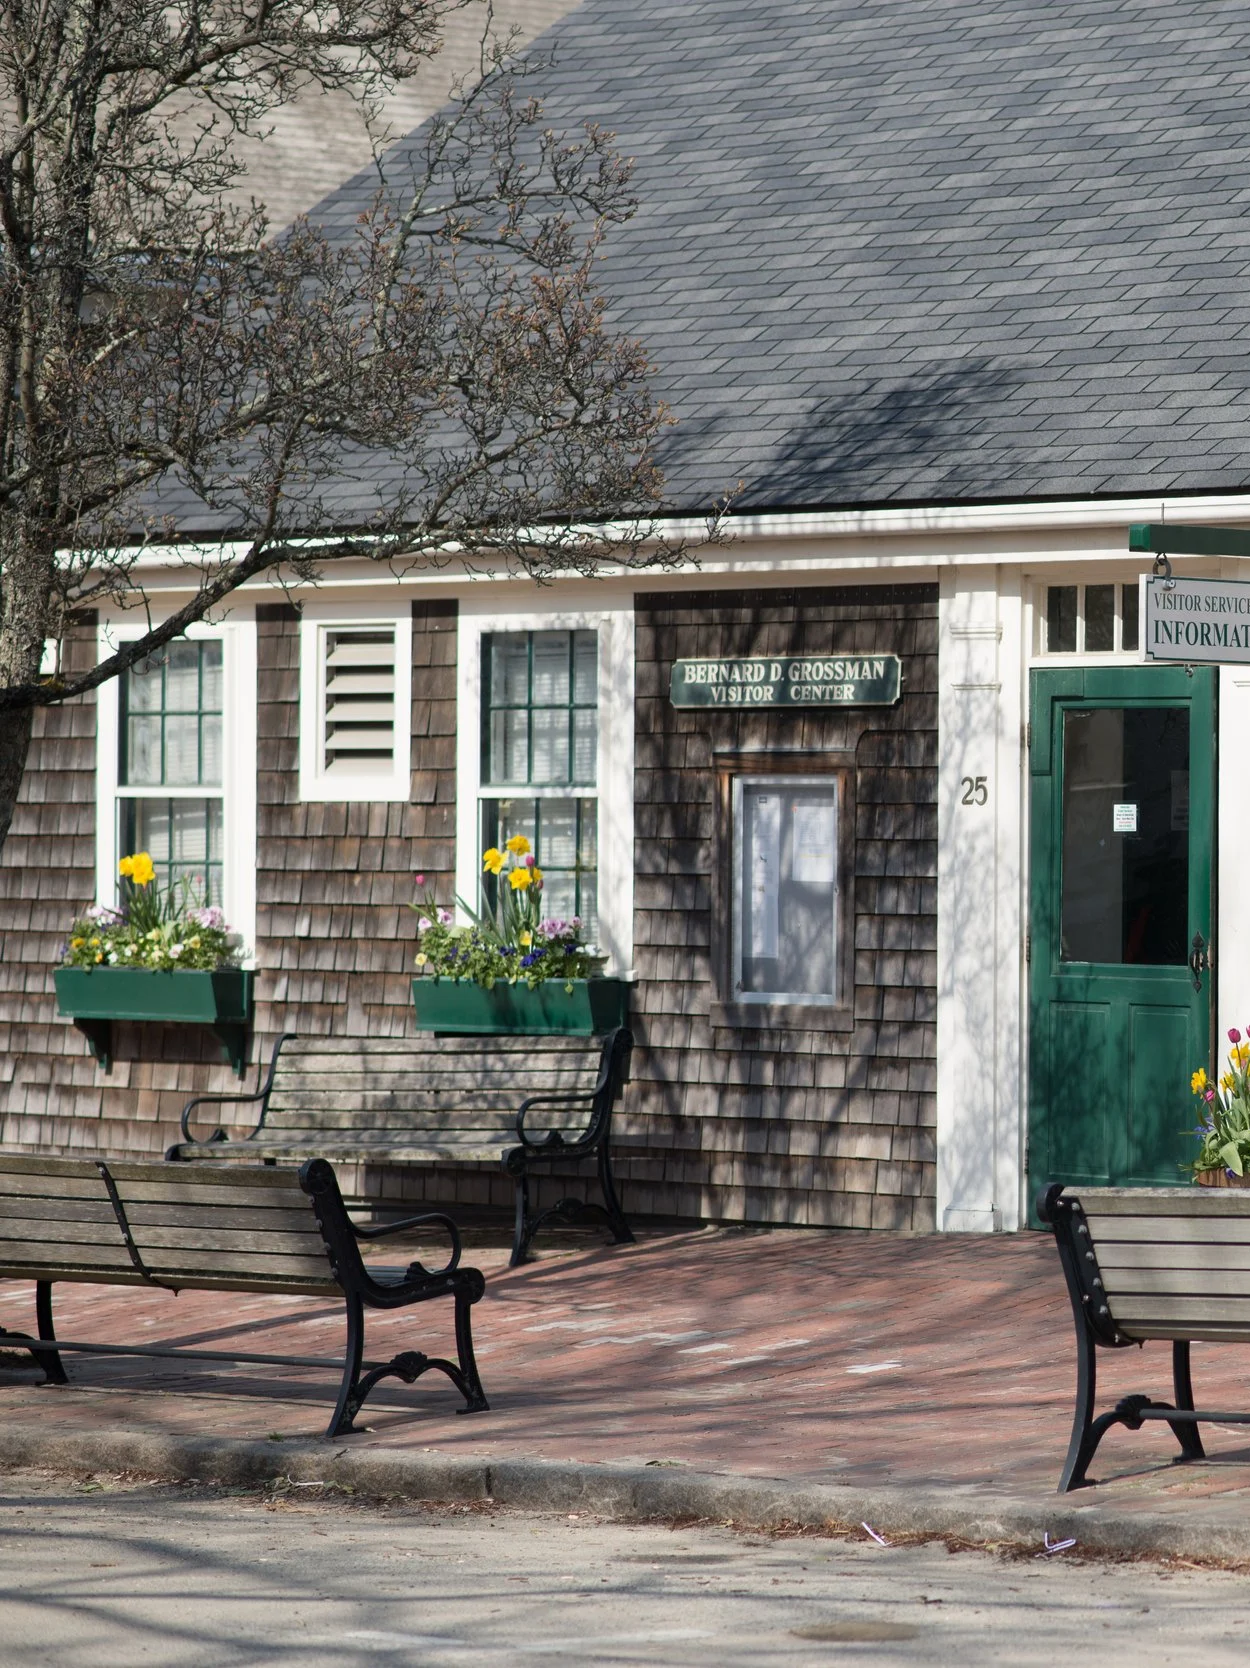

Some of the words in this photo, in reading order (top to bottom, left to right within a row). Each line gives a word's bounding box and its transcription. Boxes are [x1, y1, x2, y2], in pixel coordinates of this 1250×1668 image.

[1154, 592, 1201, 612] VISITOR
[683, 664, 766, 684] BERNARD
[769, 663, 785, 682] D.
[788, 660, 886, 682] GROSSMAN
[710, 685, 774, 703] VISITOR
[790, 684, 856, 701] CENTER
[961, 776, 989, 806] 25
